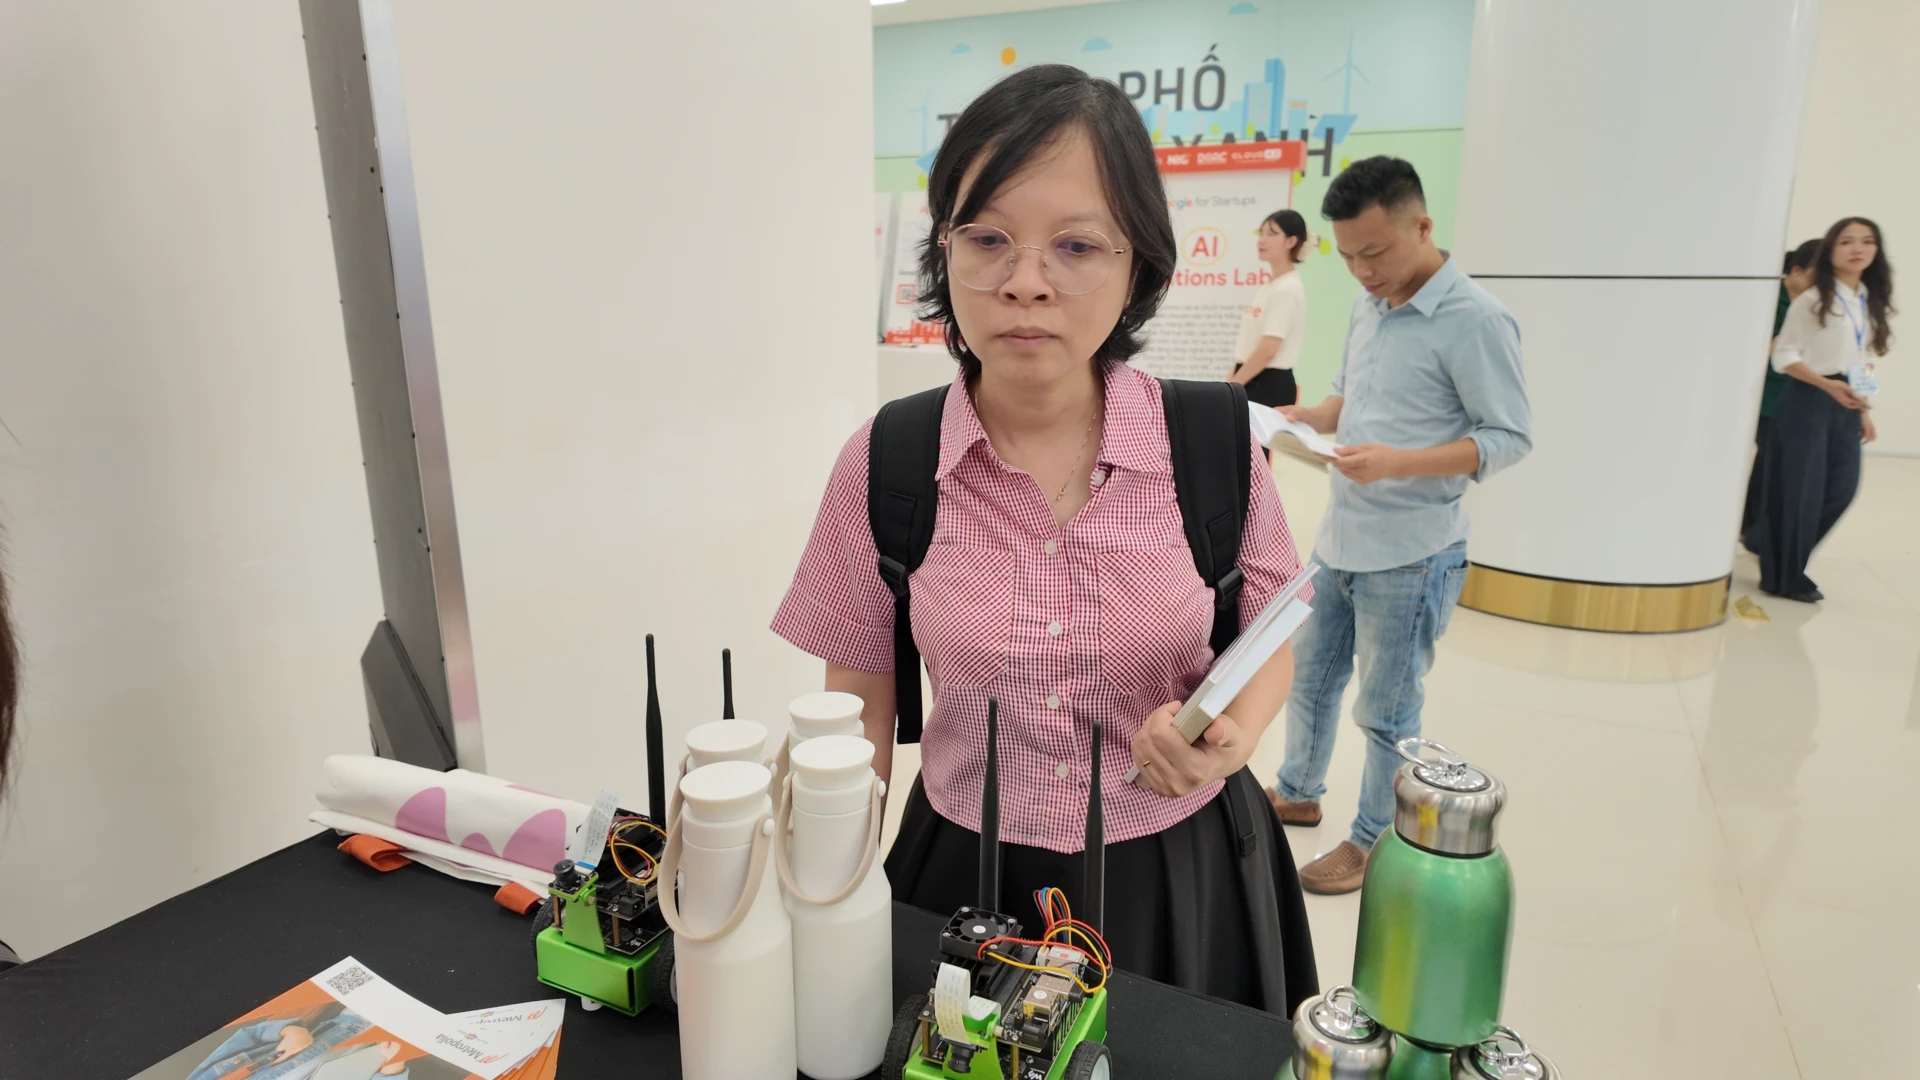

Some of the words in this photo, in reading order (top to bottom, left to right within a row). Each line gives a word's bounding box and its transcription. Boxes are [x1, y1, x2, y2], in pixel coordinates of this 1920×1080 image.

[1119, 43, 1226, 112] PHỐ
[1168, 196, 1193, 210] ogle
[1195, 196, 1209, 206] for
[1212, 195, 1256, 208] Startups
[1191, 236, 1218, 258] AI
[1171, 269, 1227, 286] tions
[1233, 268, 1272, 286] Lab
[435, 1033, 483, 1060] Metropolia
